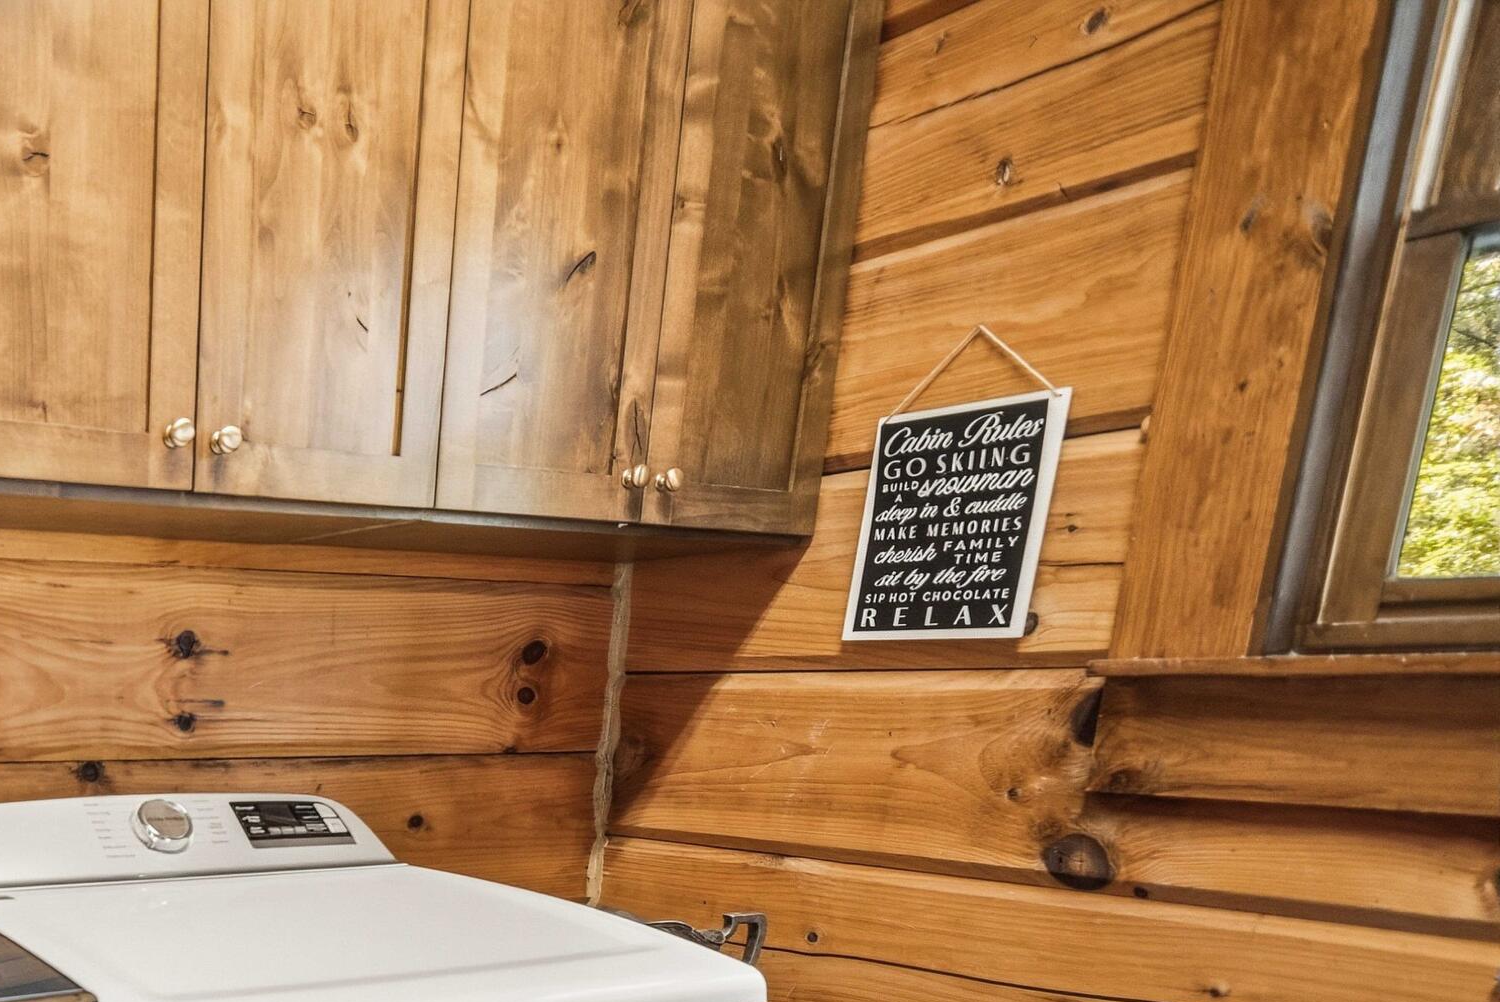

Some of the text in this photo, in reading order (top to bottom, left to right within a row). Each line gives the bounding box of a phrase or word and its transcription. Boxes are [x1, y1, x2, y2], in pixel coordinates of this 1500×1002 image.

[884, 411, 1044, 457] Cabin Rules
[884, 444, 1031, 479] GO SKIING
[882, 468, 1035, 503] BUILD A snowman
[875, 492, 1028, 525] sleep in & cuddle
[874, 516, 1022, 541] MAKE MEMORIES
[874, 536, 1019, 564] cherish FAMILY
[954, 551, 1002, 565] TIME
[874, 564, 1007, 590] sit by the fire
[865, 588, 1010, 603] SIP HOT CHOCOLATE
[860, 604, 1008, 628] RELAX
